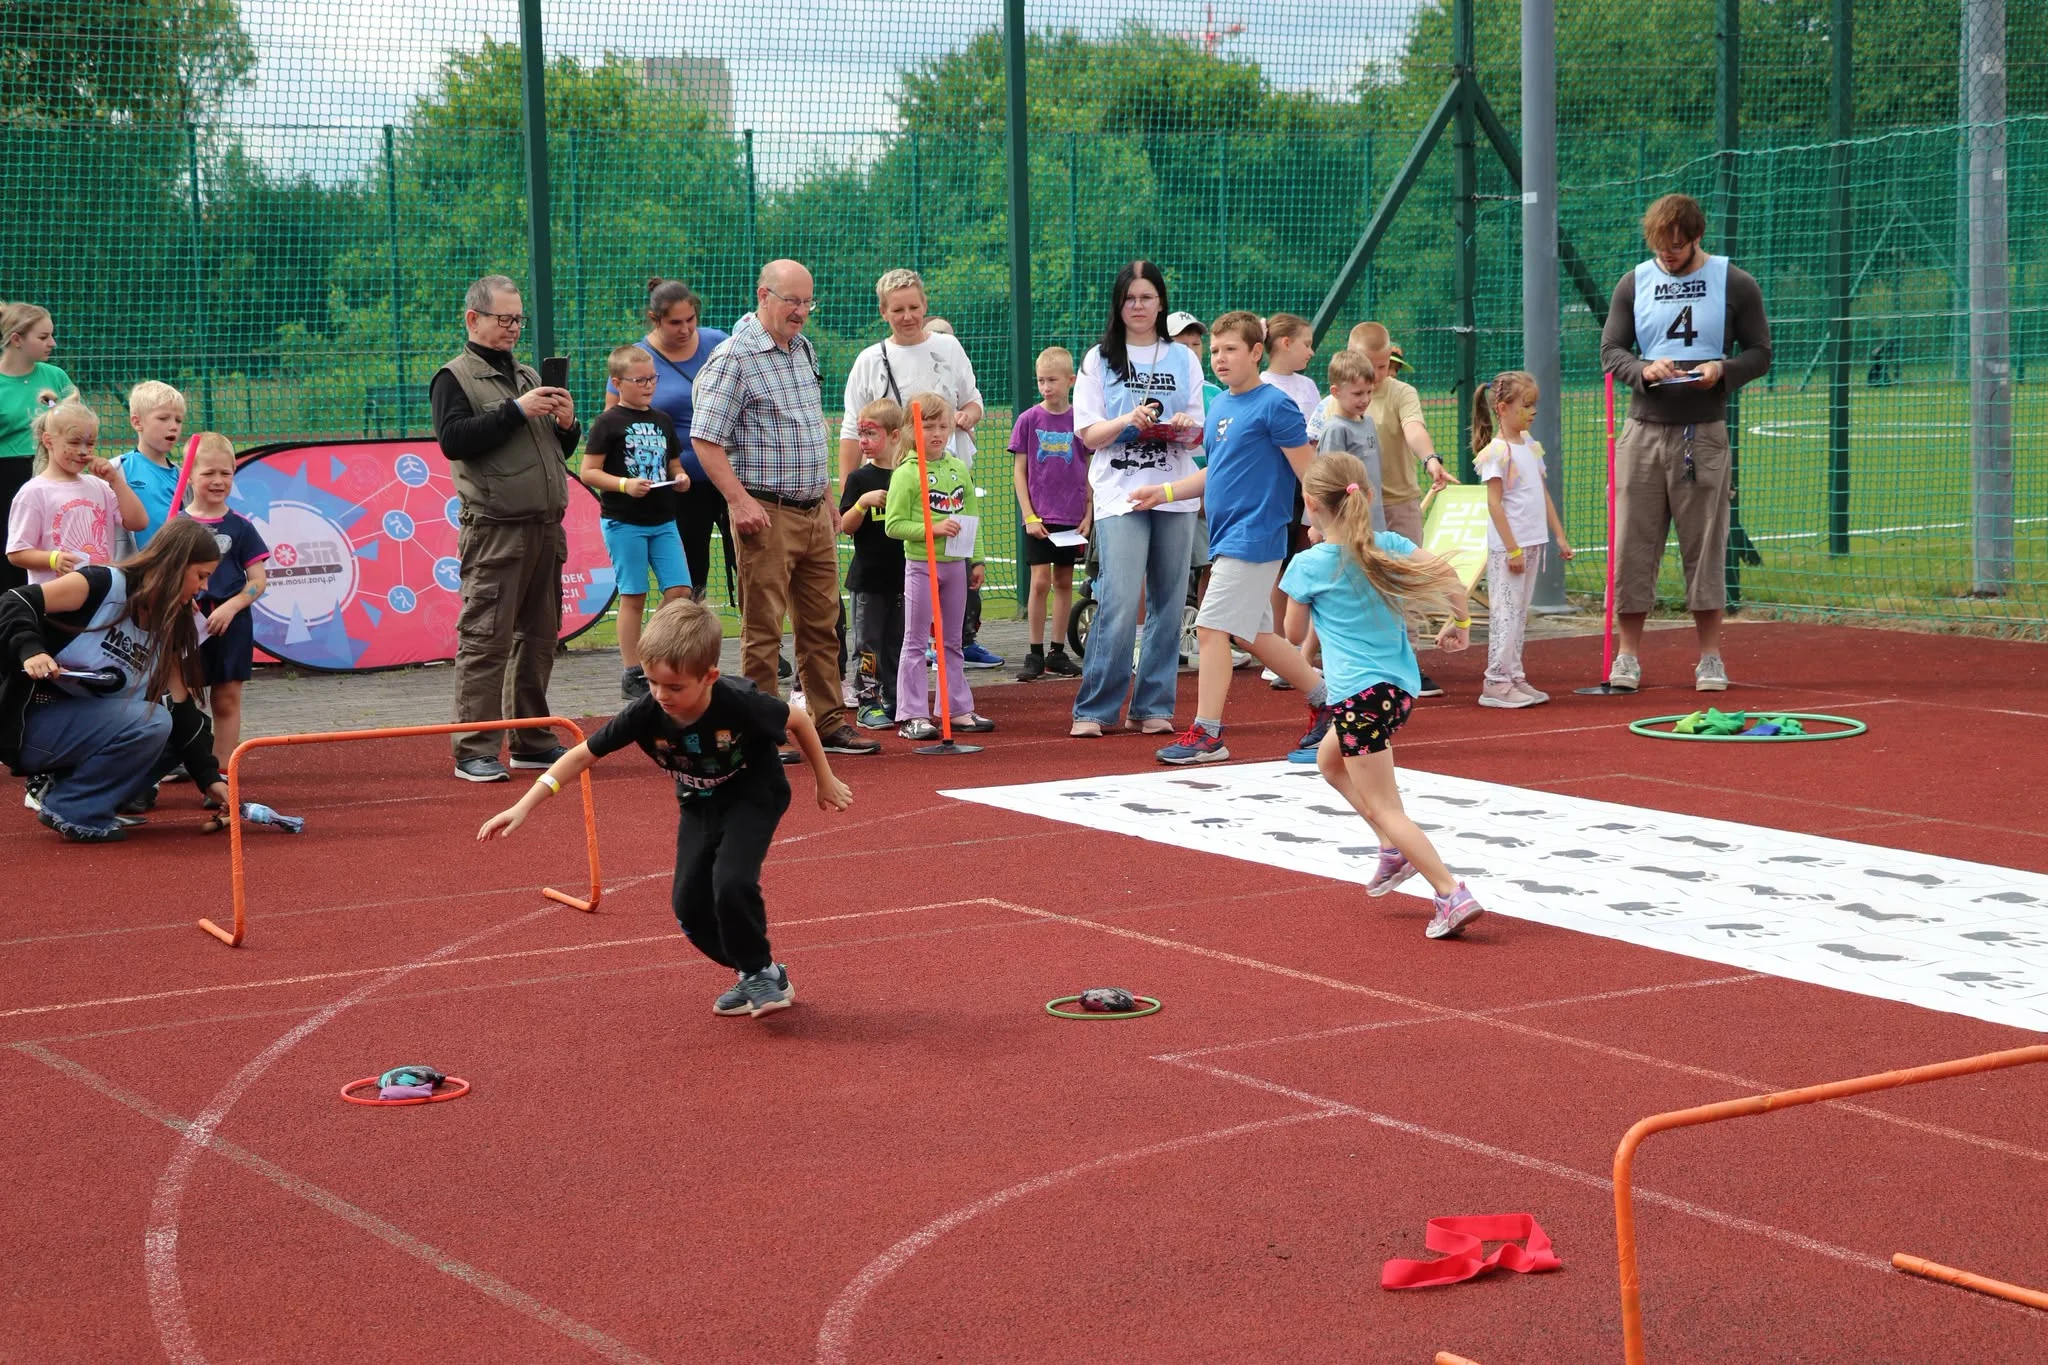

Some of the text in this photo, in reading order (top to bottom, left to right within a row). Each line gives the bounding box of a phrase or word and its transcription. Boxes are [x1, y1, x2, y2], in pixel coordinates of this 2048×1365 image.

[1665, 305, 1699, 347] 4
[631, 422, 657, 435] SIX
[624, 434, 667, 449] SEVEN
